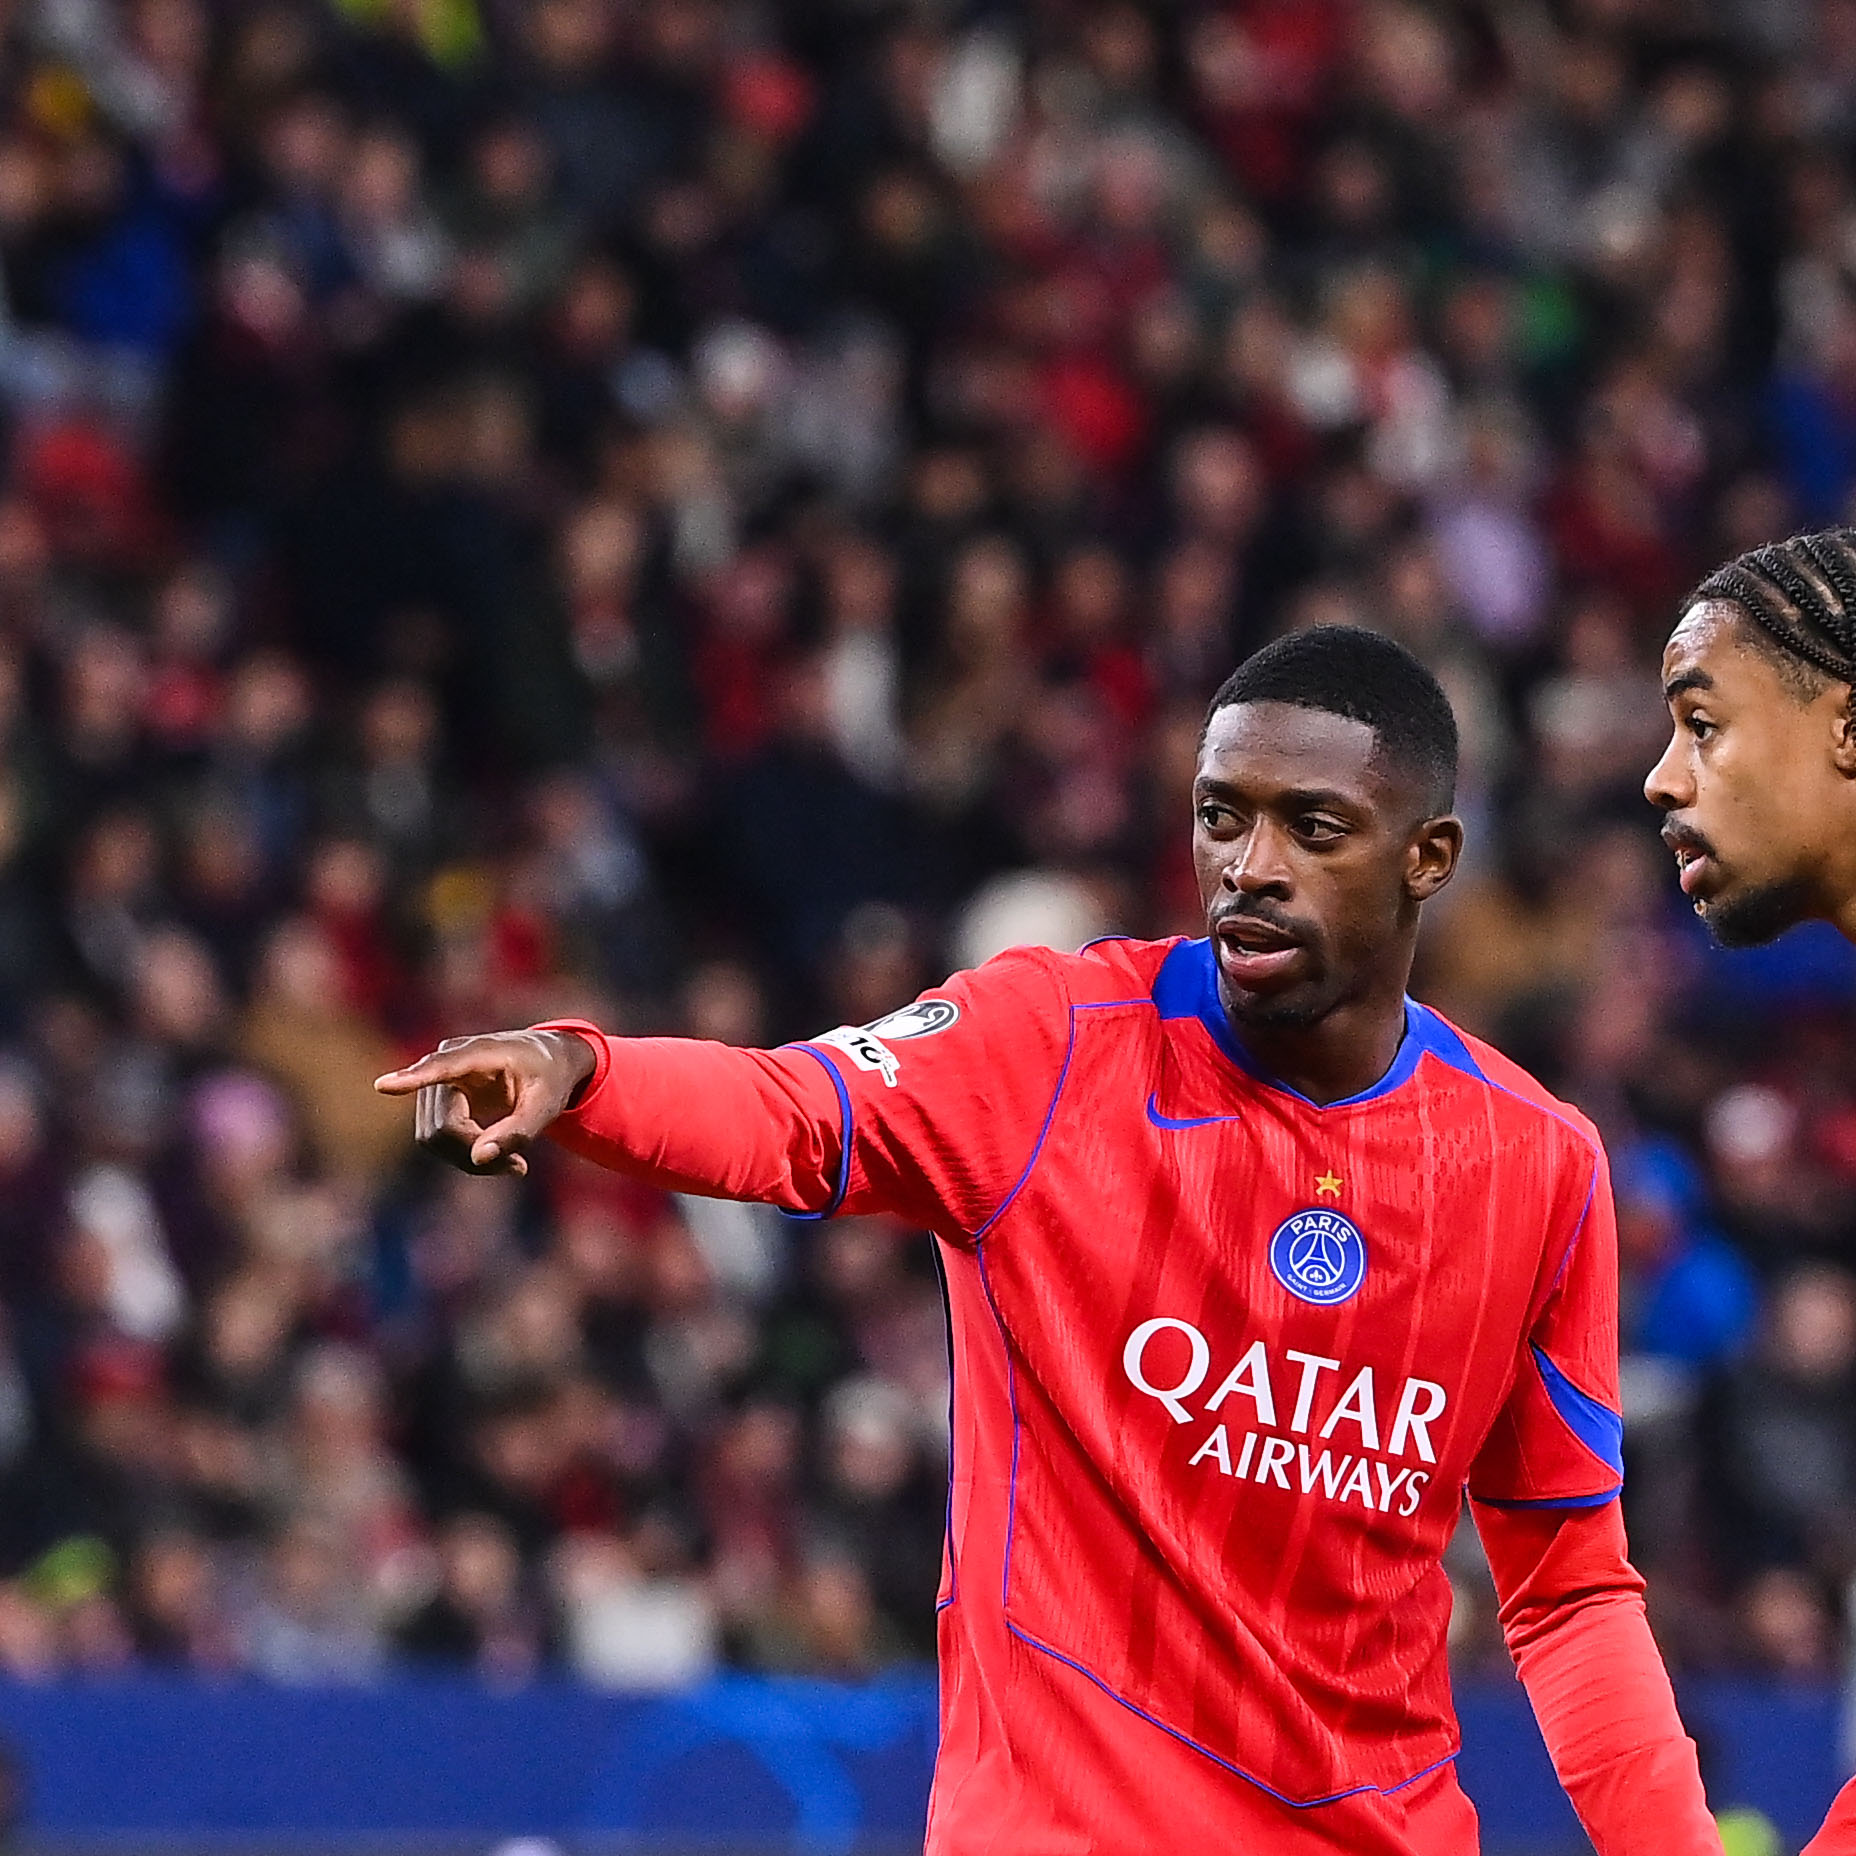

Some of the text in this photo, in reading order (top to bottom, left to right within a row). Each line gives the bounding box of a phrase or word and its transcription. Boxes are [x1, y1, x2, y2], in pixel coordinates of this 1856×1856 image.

[1290, 1215, 1352, 1243] PARIS
[1122, 1317, 1447, 1464] QATAR
[1188, 1424, 1430, 1517] AIRWAYS
